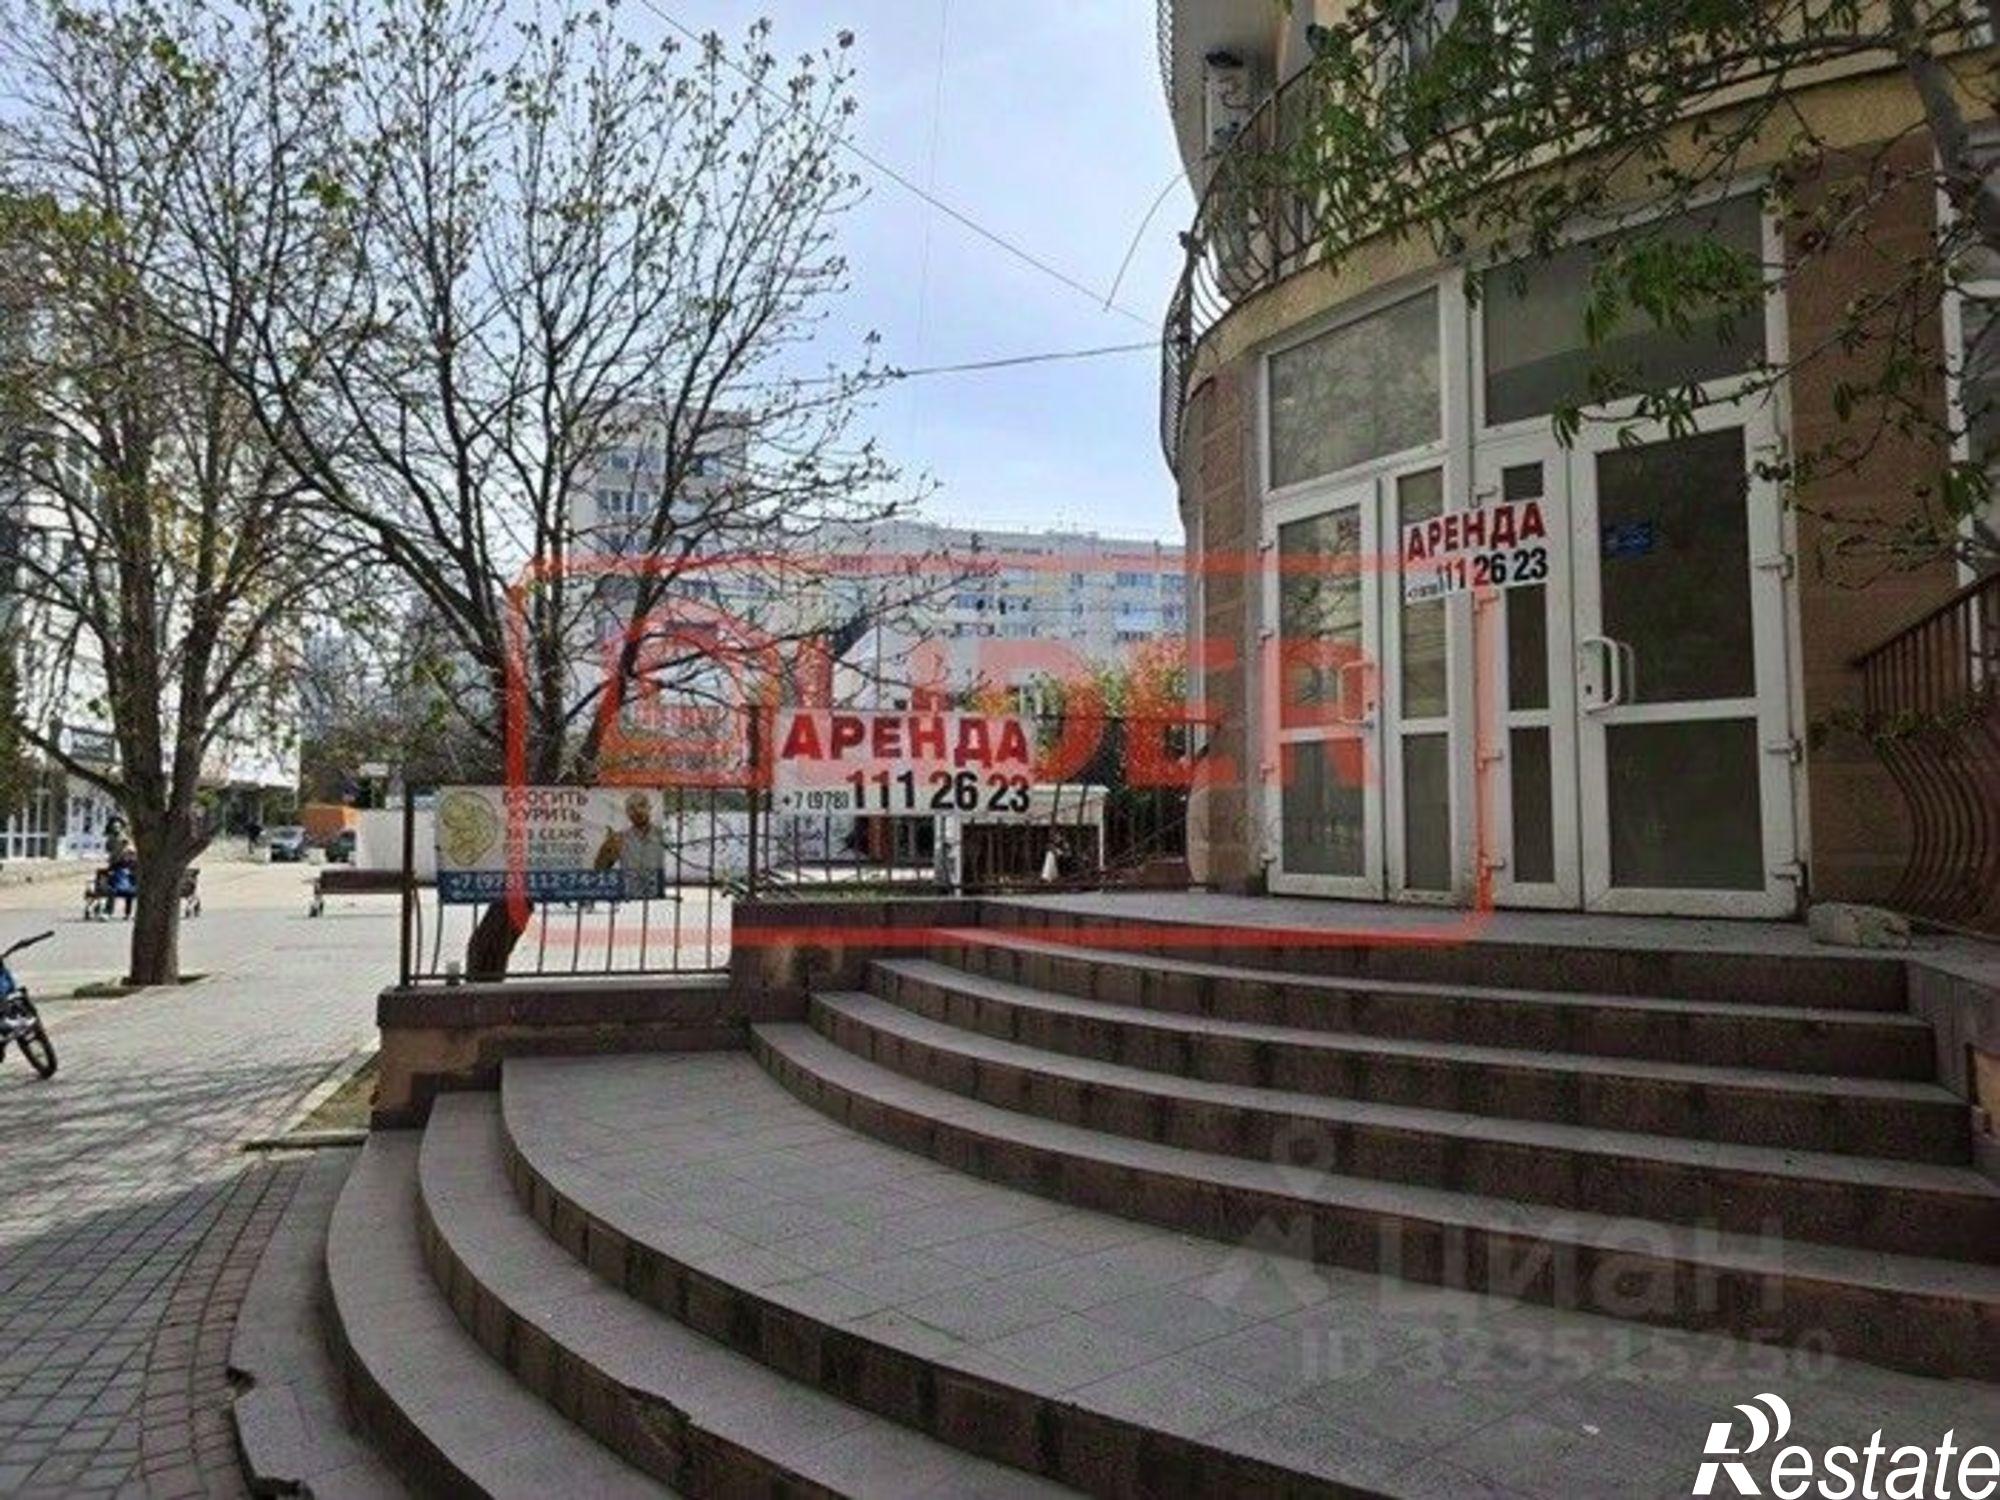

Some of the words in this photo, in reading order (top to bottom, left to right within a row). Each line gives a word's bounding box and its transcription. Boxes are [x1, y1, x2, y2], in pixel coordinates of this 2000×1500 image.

[1407, 502, 1546, 562] АРЕНДА
[1473, 552, 1507, 587] 26
[1513, 547, 1548, 581] 23
[781, 713, 1030, 768] АРЕНДА
[847, 769, 917, 809] 111
[929, 770, 978, 810] 26
[986, 772, 1030, 812] 23
